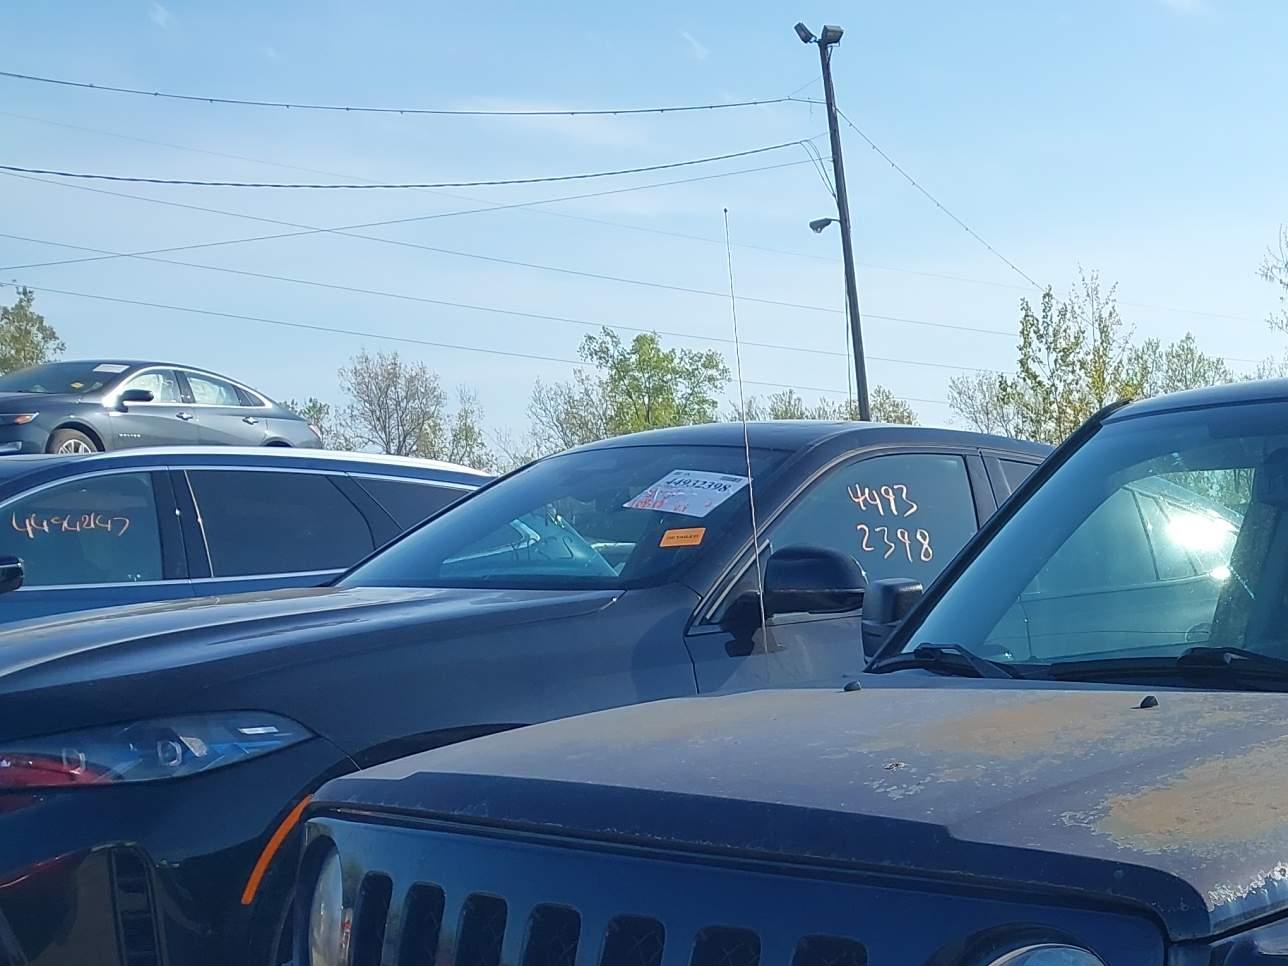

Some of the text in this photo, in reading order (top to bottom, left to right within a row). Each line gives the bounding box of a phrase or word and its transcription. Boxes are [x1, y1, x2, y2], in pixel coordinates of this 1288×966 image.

[666, 478, 732, 493] 44932398
[848, 484, 918, 517] 4493
[857, 524, 933, 563] 2398
